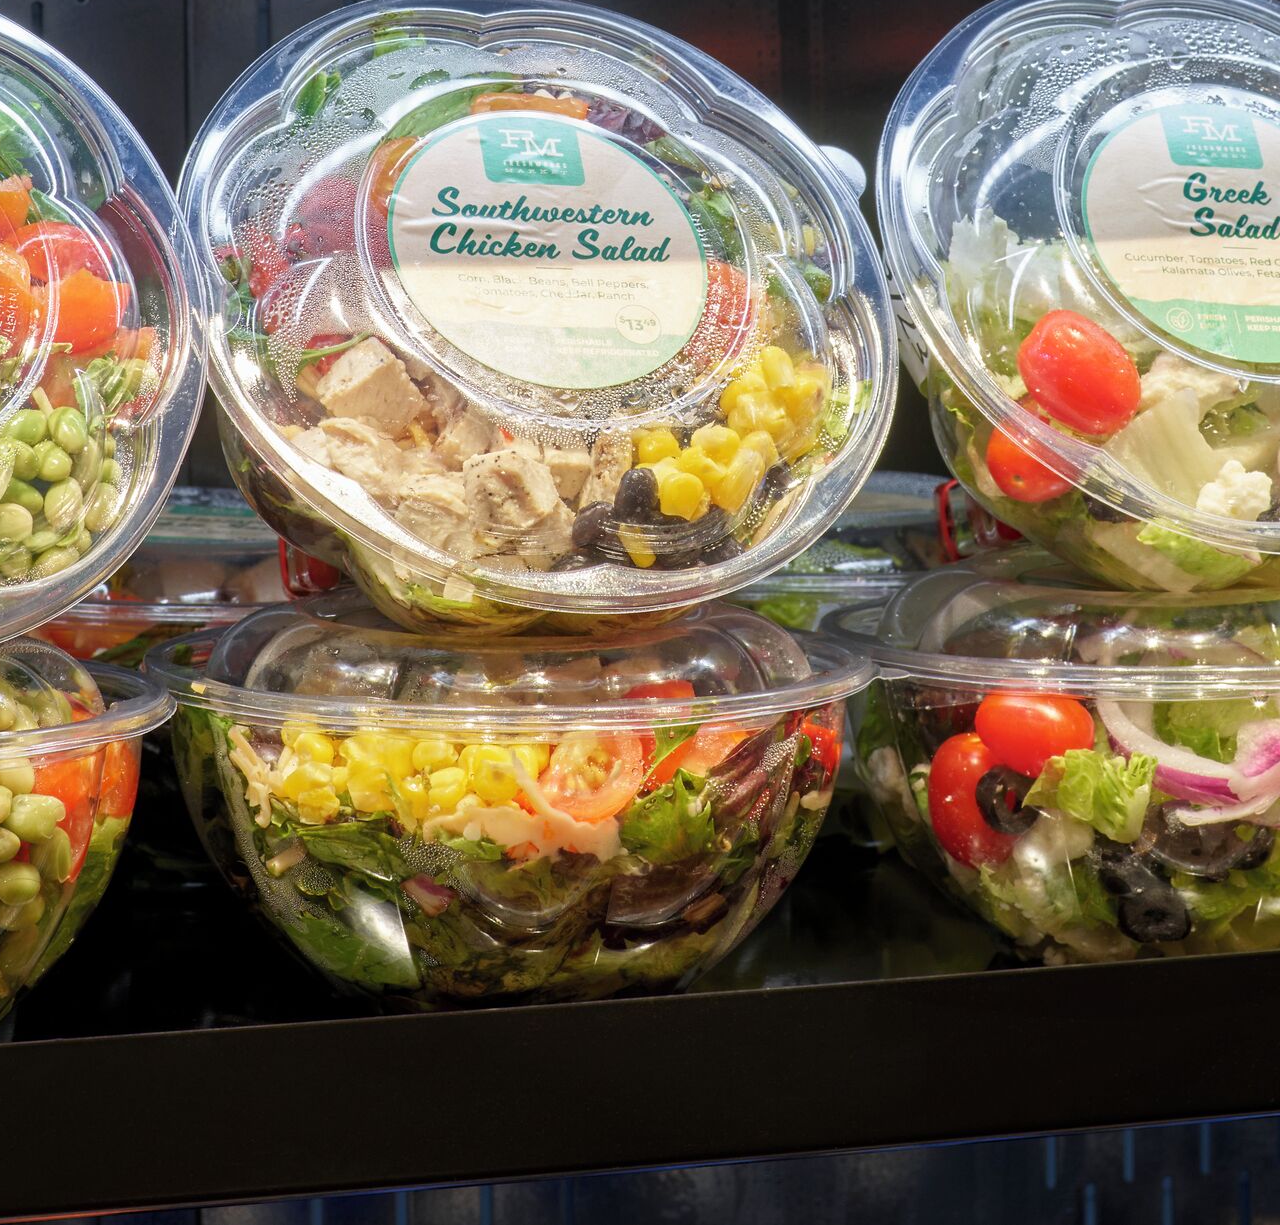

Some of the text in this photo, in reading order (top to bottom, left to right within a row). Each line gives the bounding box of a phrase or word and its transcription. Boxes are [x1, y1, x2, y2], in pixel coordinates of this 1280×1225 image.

[1182, 172, 1272, 206] Greek
[431, 186, 655, 226] Southwestern
[429, 222, 562, 259] Chicken
[572, 229, 672, 264] Salad
[1124, 253, 1187, 264] Cucumber,
[1189, 254, 1247, 266] Tomatoes,
[1250, 256, 1271, 266] Red
[529, 277, 649, 291] Beans, Peppers,
[1162, 266, 1215, 276] Kalamata
[1218, 267, 1255, 278] Olives,
[1257, 269, 1280, 279] Feta
